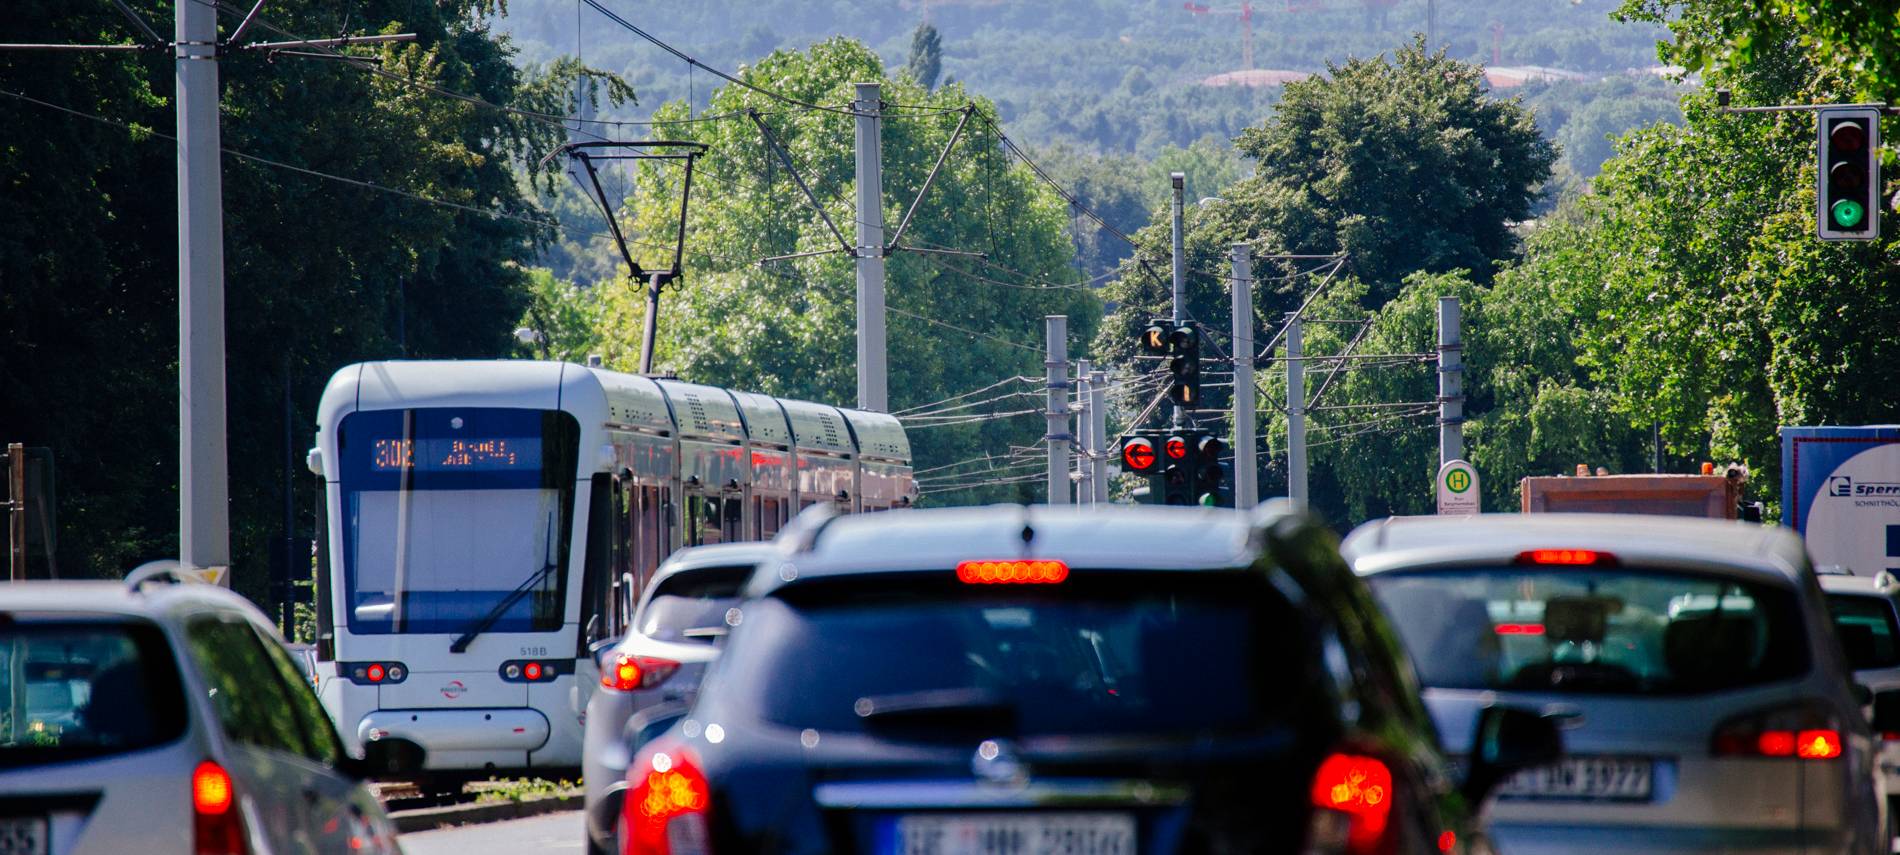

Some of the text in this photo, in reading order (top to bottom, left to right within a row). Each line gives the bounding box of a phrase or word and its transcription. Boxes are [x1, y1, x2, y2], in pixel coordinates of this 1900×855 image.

[1150, 330, 1163, 347] K
[376, 440, 414, 467] 302
[1453, 473, 1464, 488] H
